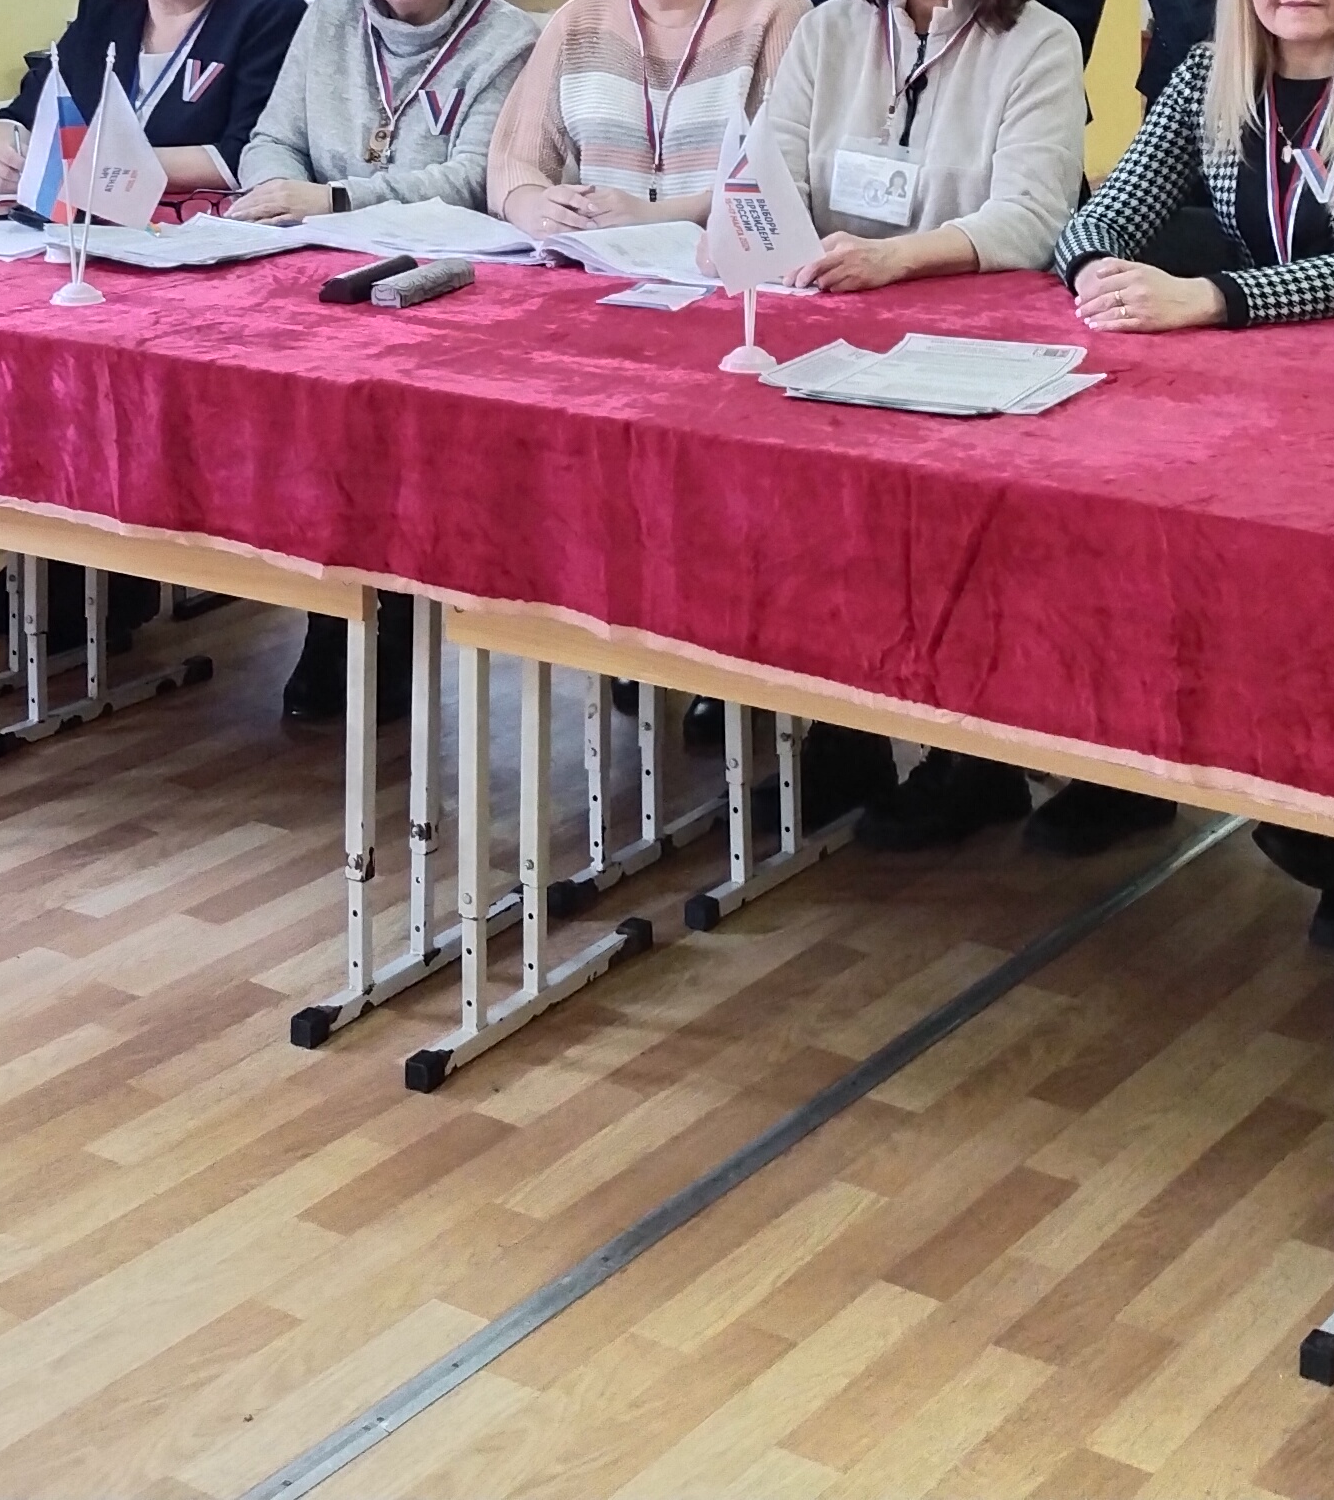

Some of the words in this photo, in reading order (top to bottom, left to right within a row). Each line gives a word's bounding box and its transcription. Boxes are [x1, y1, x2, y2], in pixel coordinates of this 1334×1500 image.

[732, 197, 755, 232] РОССИИ
[743, 198, 775, 252] ПРЕЗИДЕНТА
[755, 198, 781, 236] ВЫБОРЫ
